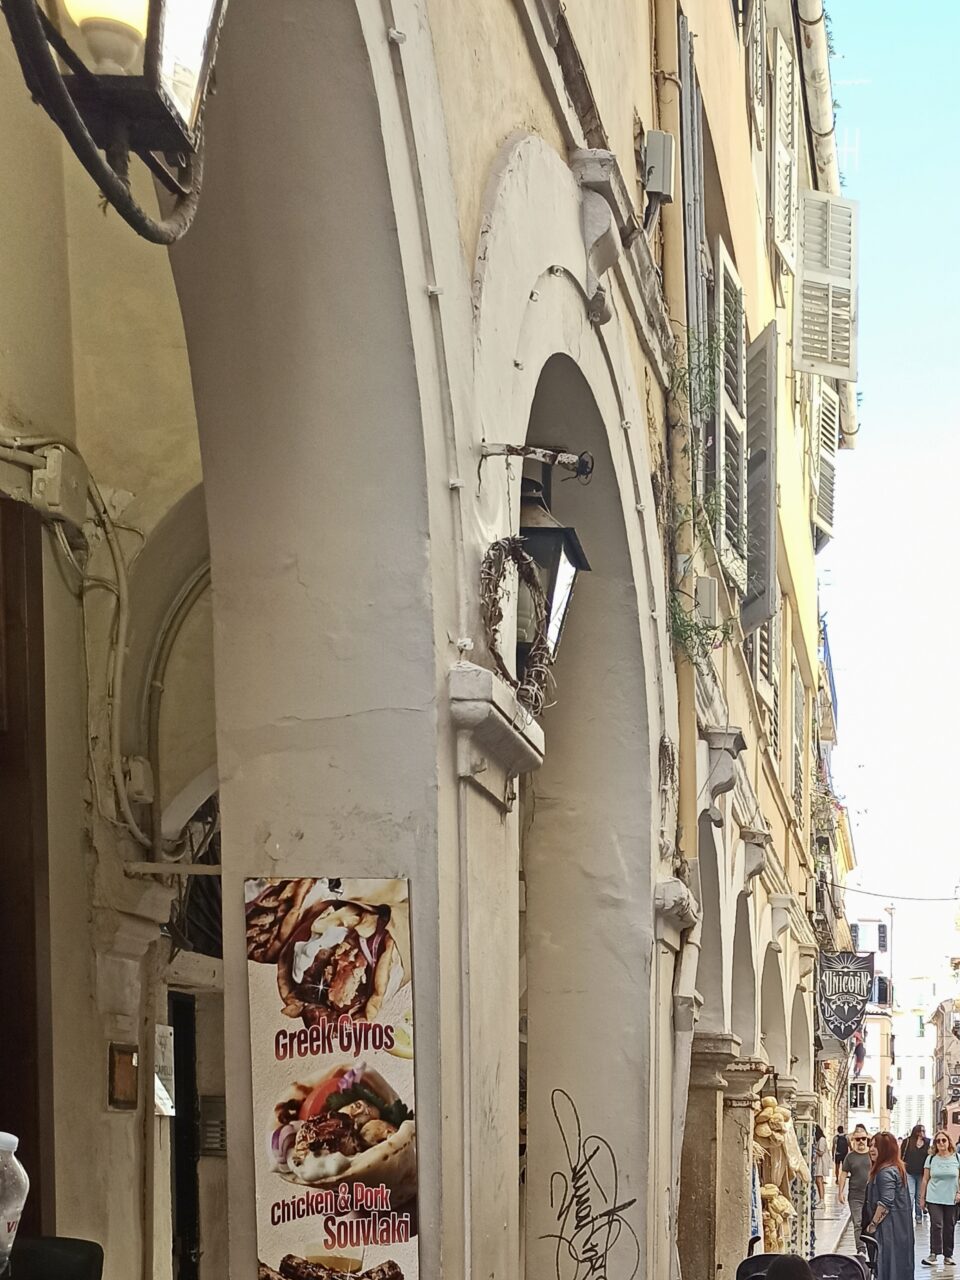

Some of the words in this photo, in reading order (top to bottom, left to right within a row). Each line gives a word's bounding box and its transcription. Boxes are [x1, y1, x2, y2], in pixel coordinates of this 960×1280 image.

[823, 971, 870, 996] UNICORN
[275, 1016, 334, 1061] Greek
[339, 1013, 395, 1058] Gyros
[270, 1189, 335, 1226] Chicken
[336, 1182, 351, 1212] &
[353, 1182, 391, 1211] Pork
[323, 1212, 411, 1251] Souvlaki
